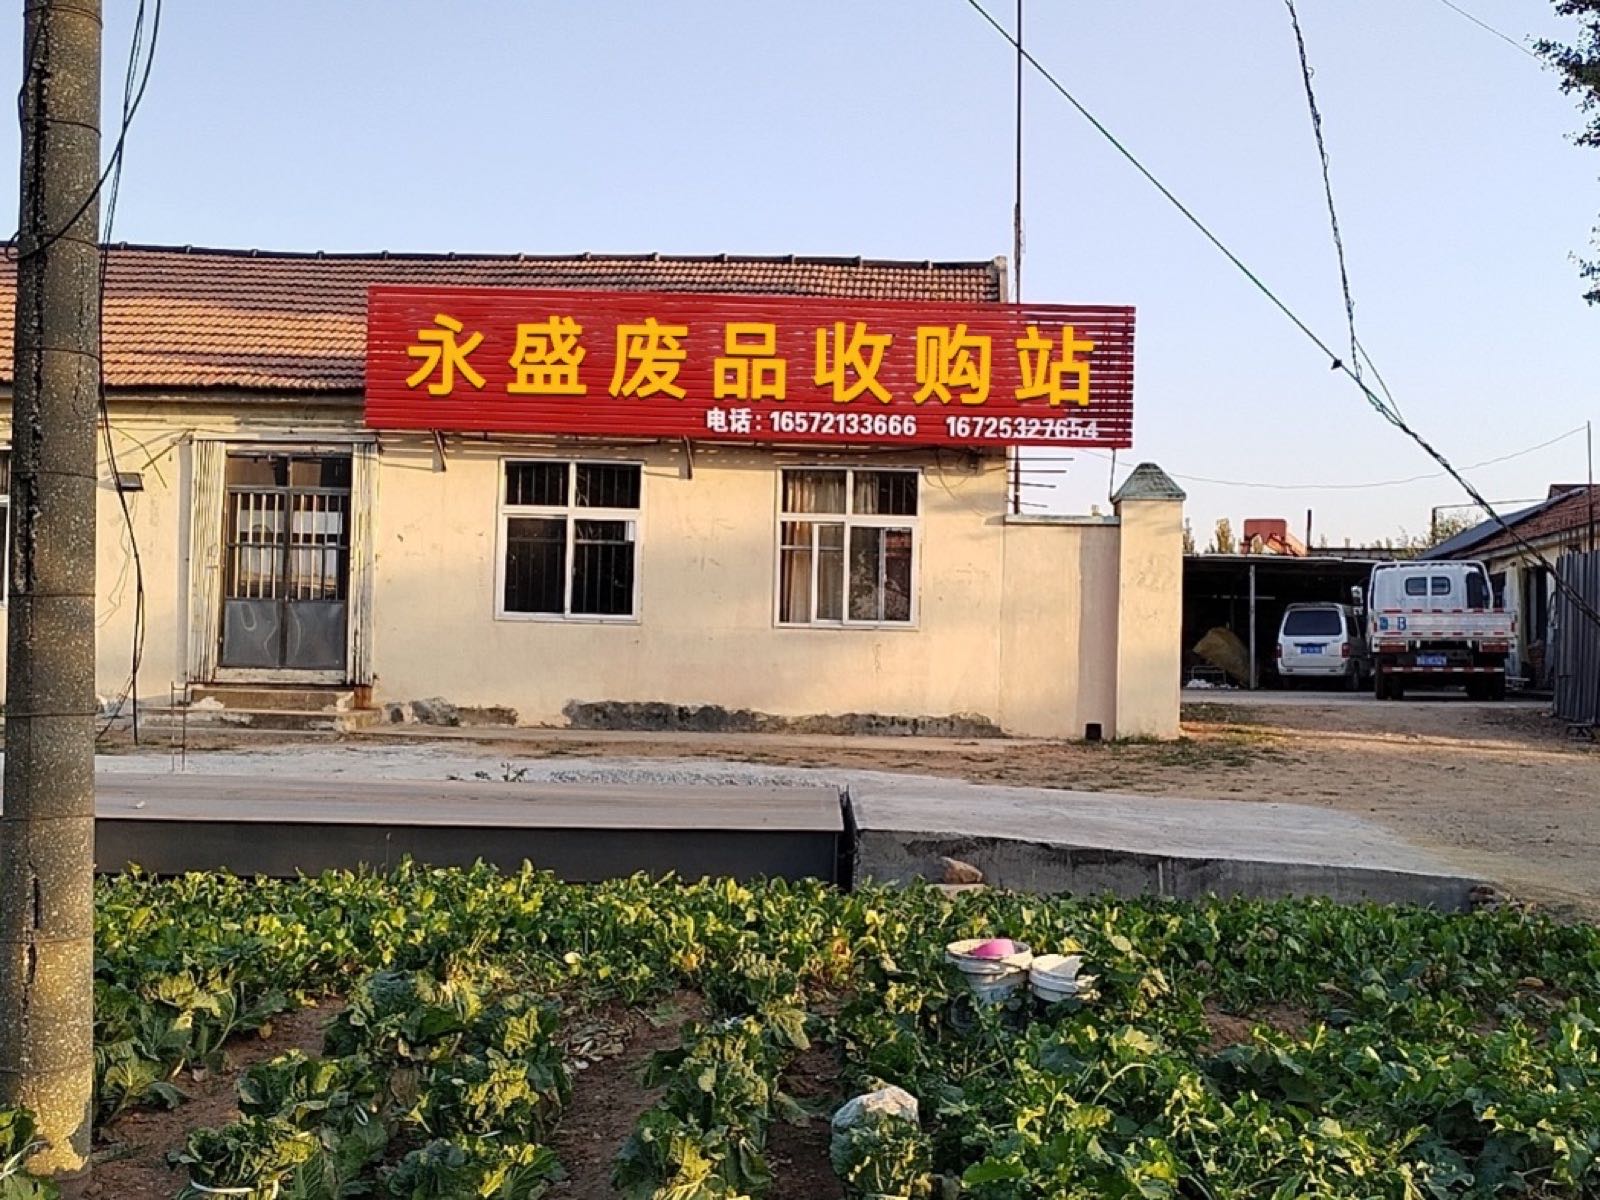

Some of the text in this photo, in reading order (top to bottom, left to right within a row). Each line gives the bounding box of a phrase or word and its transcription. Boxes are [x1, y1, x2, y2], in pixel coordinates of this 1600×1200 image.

[406, 313, 1096, 407] 永盛废品收购站
[946, 416, 1100, 439] 16725327654
